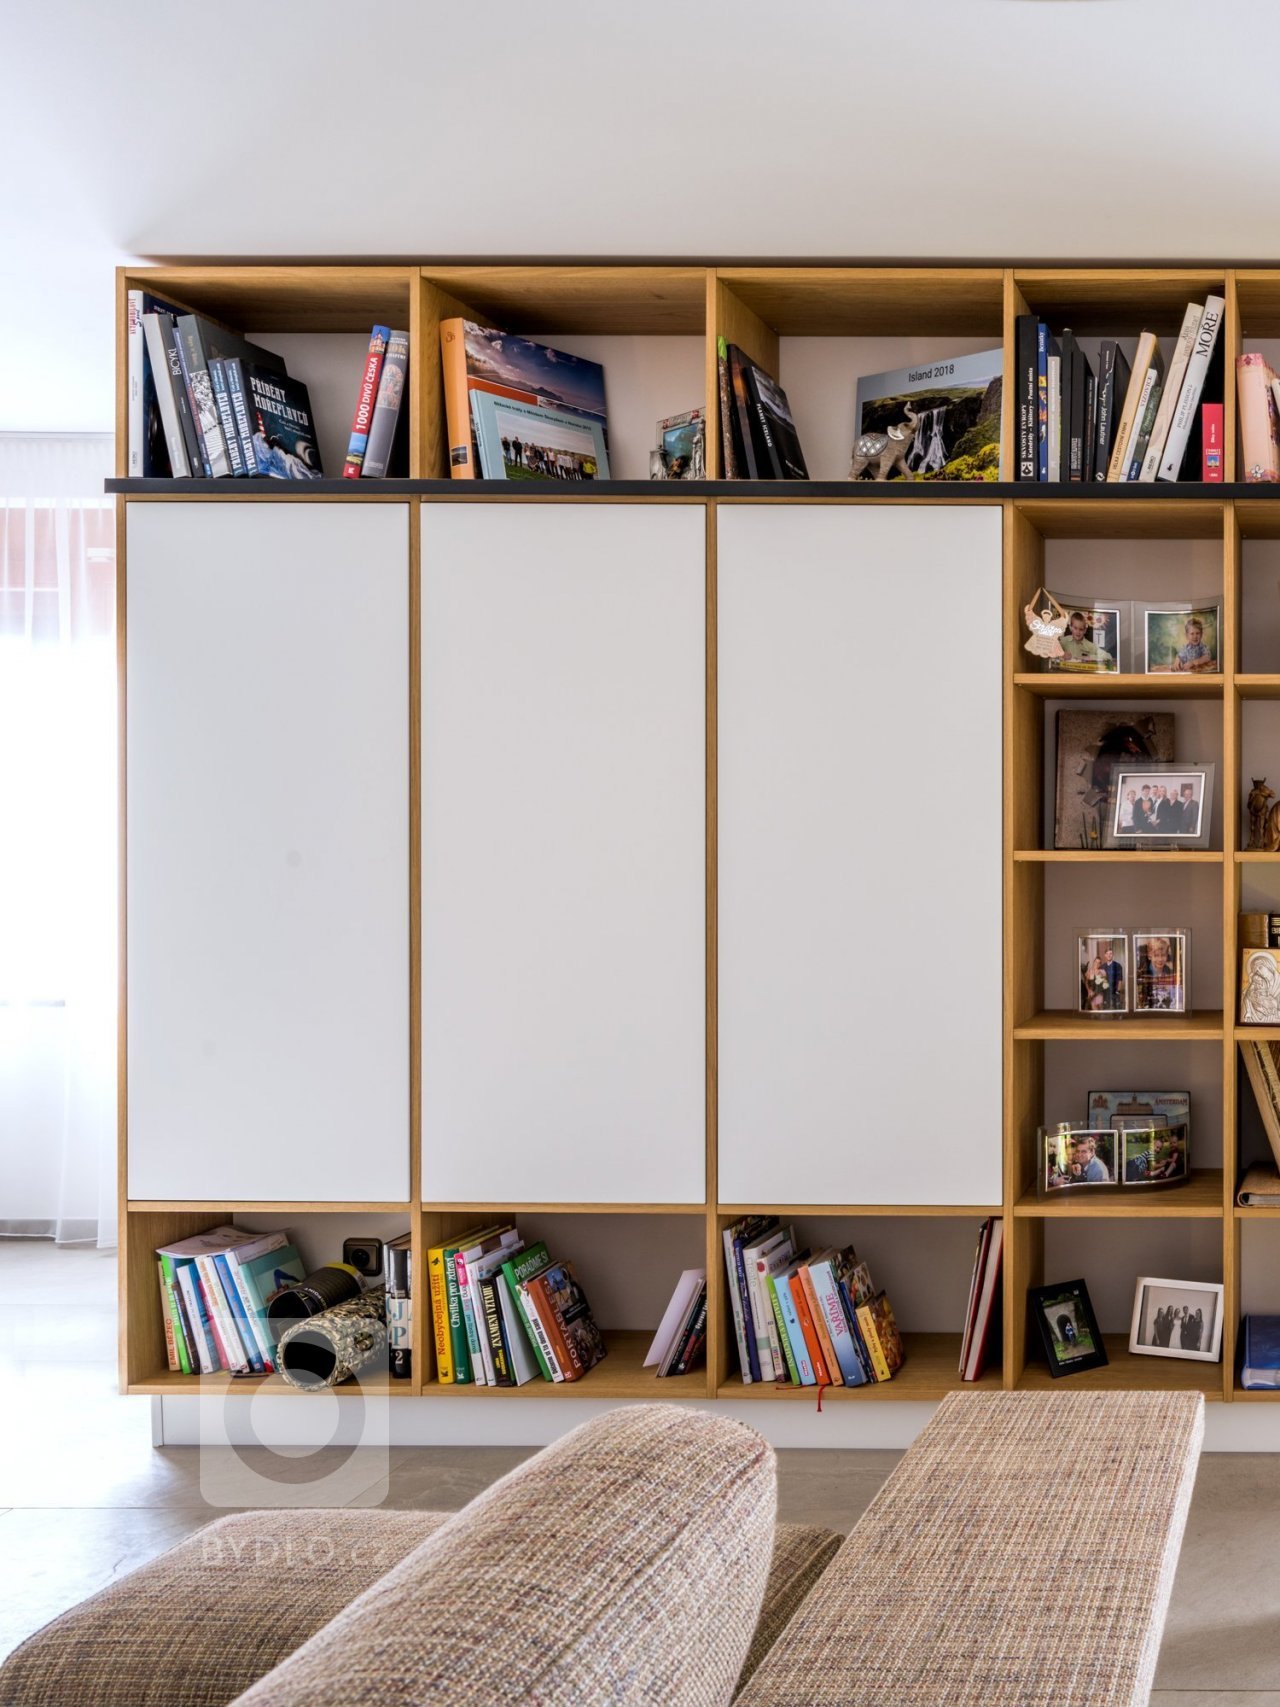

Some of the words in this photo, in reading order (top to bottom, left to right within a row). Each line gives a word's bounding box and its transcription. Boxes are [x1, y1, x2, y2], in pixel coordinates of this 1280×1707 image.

[1196, 312, 1219, 358] MOŘE
[908, 369, 932, 382] Island
[934, 364, 955, 378] 2018
[250, 376, 287, 403] PŘÍBĚHY
[356, 404, 370, 430] 1000
[366, 357, 378, 382] ČESKA
[1140, 376, 1153, 408] VIZOVICE
[216, 392, 235, 438] MOŘEPLAVCŮ
[231, 391, 250, 438] MOŘEPLAVCŮ
[253, 393, 308, 426] MOŘEPLAVCŮ
[757, 403, 766, 423] PLANET
[762, 424, 773, 447] ICELAND
[1099, 422, 1107, 445] Lautner
[227, 439, 242, 469] PŘÍBĚHY
[243, 438, 256, 469] PŘÍBĚHY
[445, 1256, 455, 1281] zdraví
[514, 1255, 541, 1281] PORAĎME
[432, 1274, 441, 1296] užití
[448, 1281, 461, 1296] pro
[482, 1285, 496, 1313] VZTAHŮ
[433, 1298, 446, 1355] Neobyčejná
[449, 1296, 461, 1328] Chvilka
[826, 1293, 844, 1336] VAŘÍME
[165, 1318, 175, 1345] BĚŽEC
[488, 1314, 502, 1348] ZNAMENÍ
[537, 1330, 546, 1345] doma
[545, 1286, 581, 1369] PORTABLES
[169, 1347, 177, 1366] EMIL
[395, 1351, 404, 1364] 2
